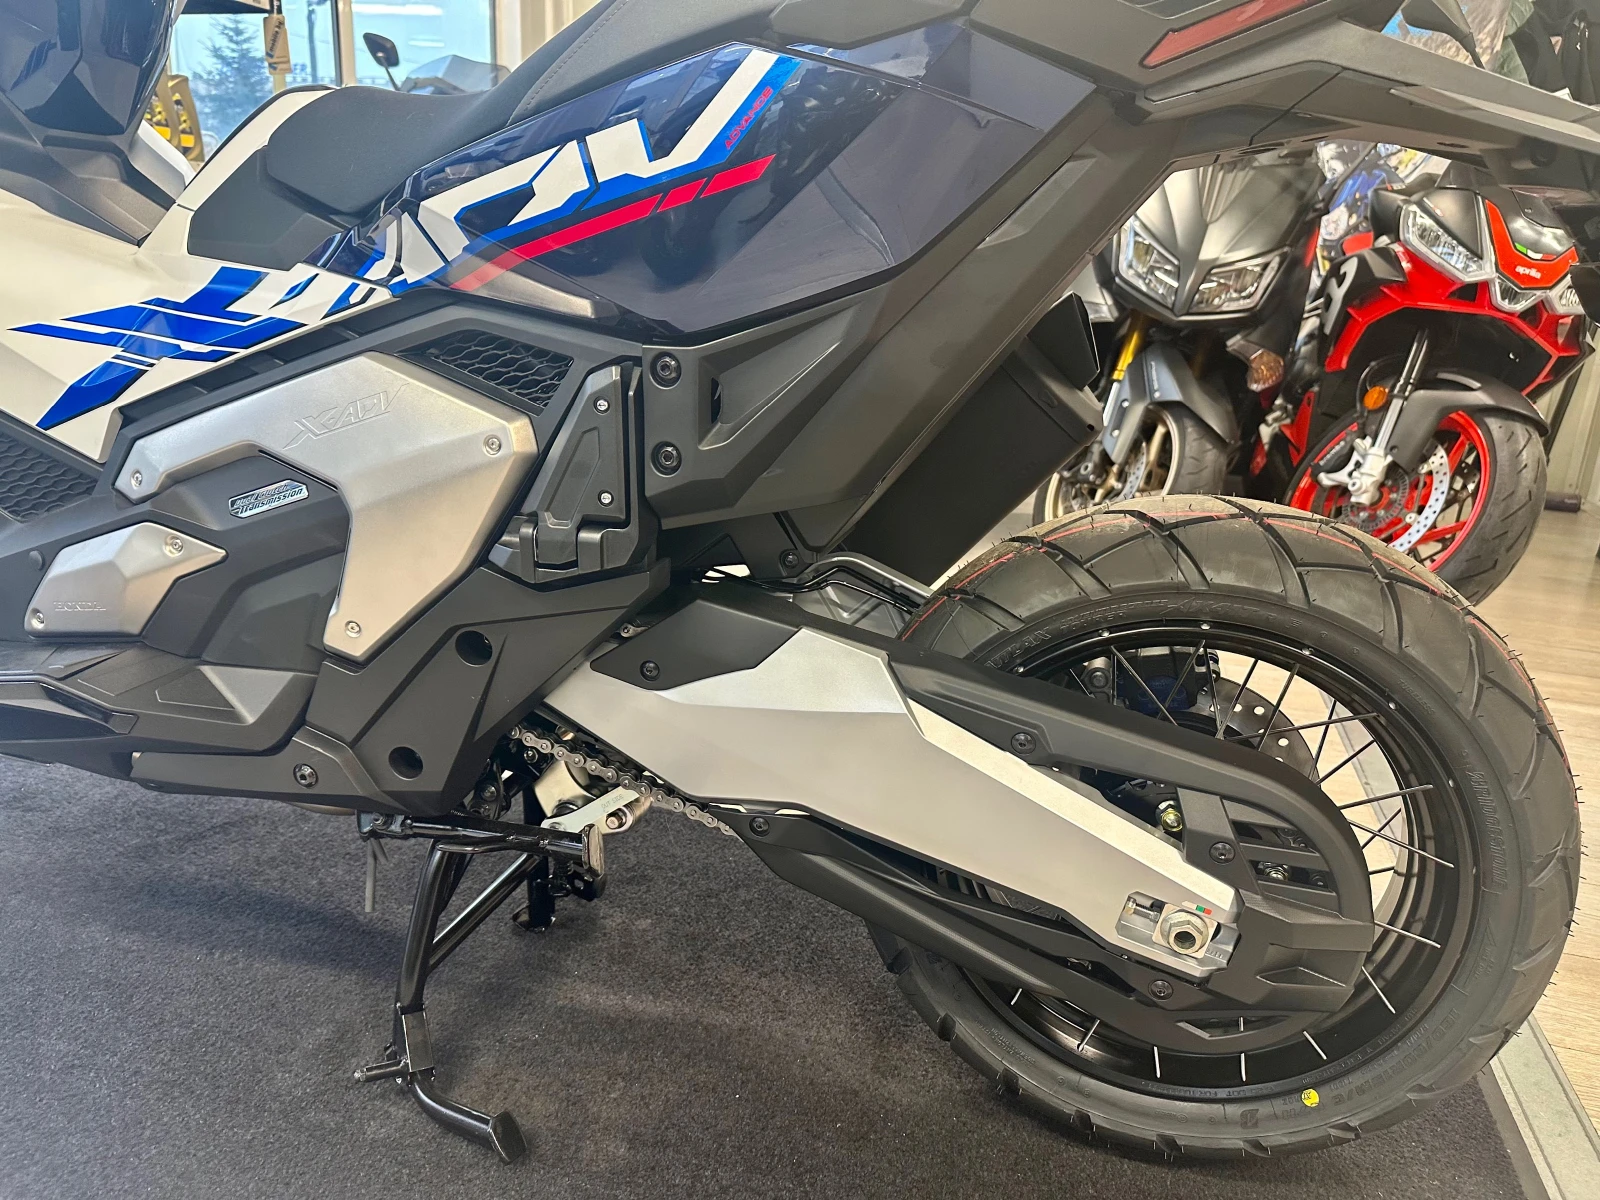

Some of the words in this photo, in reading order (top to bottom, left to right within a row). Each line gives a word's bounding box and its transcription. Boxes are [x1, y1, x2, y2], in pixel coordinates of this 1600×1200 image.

[724, 86, 774, 151] ADVANCE
[1515, 265, 1542, 279] aprilia
[239, 488, 303, 515] Transmission
